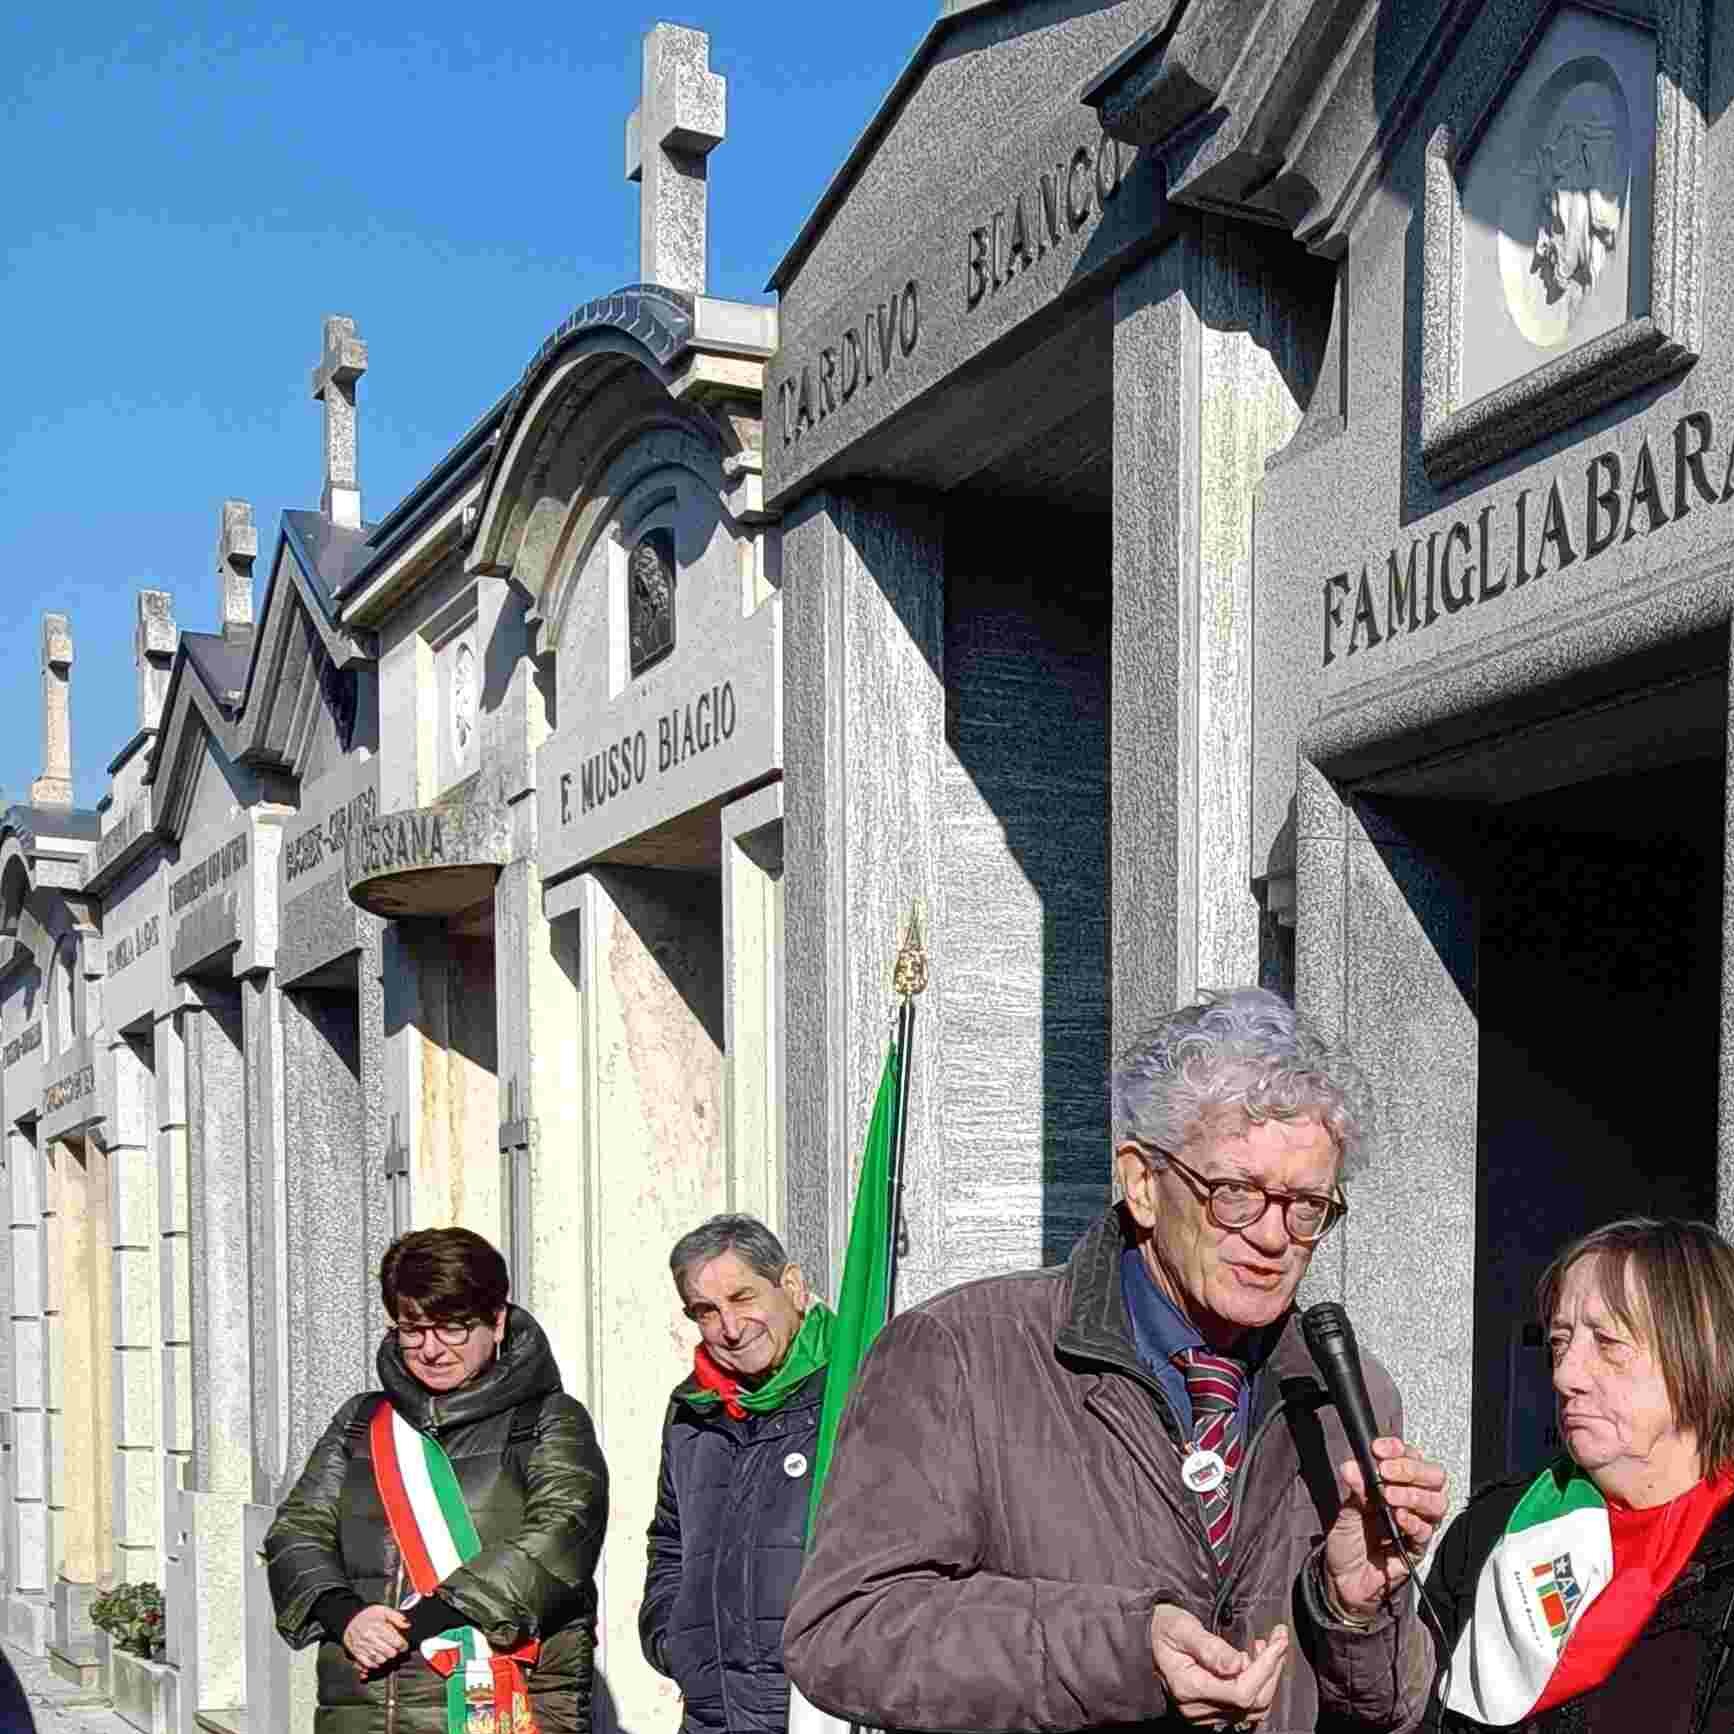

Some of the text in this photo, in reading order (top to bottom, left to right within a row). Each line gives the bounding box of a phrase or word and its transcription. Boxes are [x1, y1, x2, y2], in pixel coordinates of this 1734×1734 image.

[779, 138, 1120, 450] TARDIVO BIANCO
[581, 729, 647, 815] MUSSO
[658, 679, 737, 773] BIAGIO
